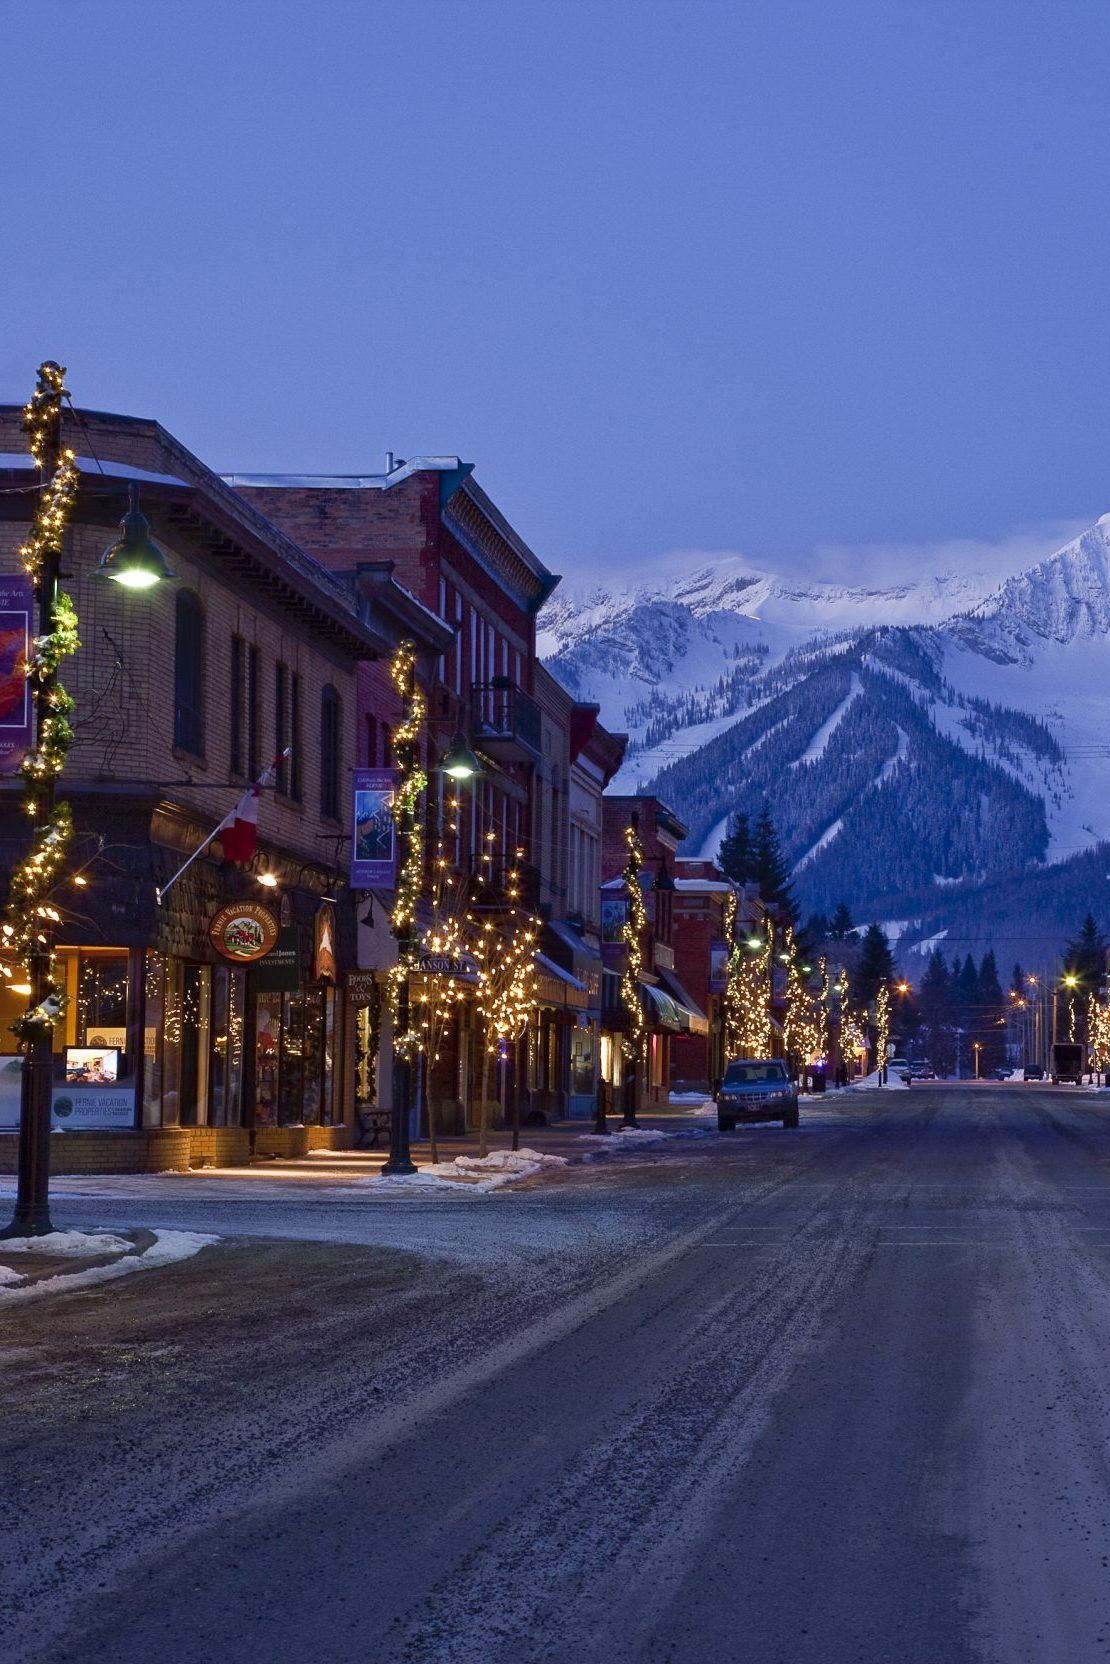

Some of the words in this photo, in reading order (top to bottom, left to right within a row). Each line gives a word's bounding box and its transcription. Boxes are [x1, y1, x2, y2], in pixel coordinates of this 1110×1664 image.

[211, 915, 227, 936] FERNIE
[225, 905, 254, 917] VACATION
[254, 906, 277, 936] PROPERTIES
[259, 959, 296, 967] INVESTMENTS
[453, 961, 464, 971] ST
[348, 974, 373, 987] BOOKS
[350, 993, 372, 1001] TOYS
[75, 1097, 97, 1107] FERNIE
[99, 1097, 128, 1107] VACATION
[74, 1107, 113, 1117] PROPERTIES
